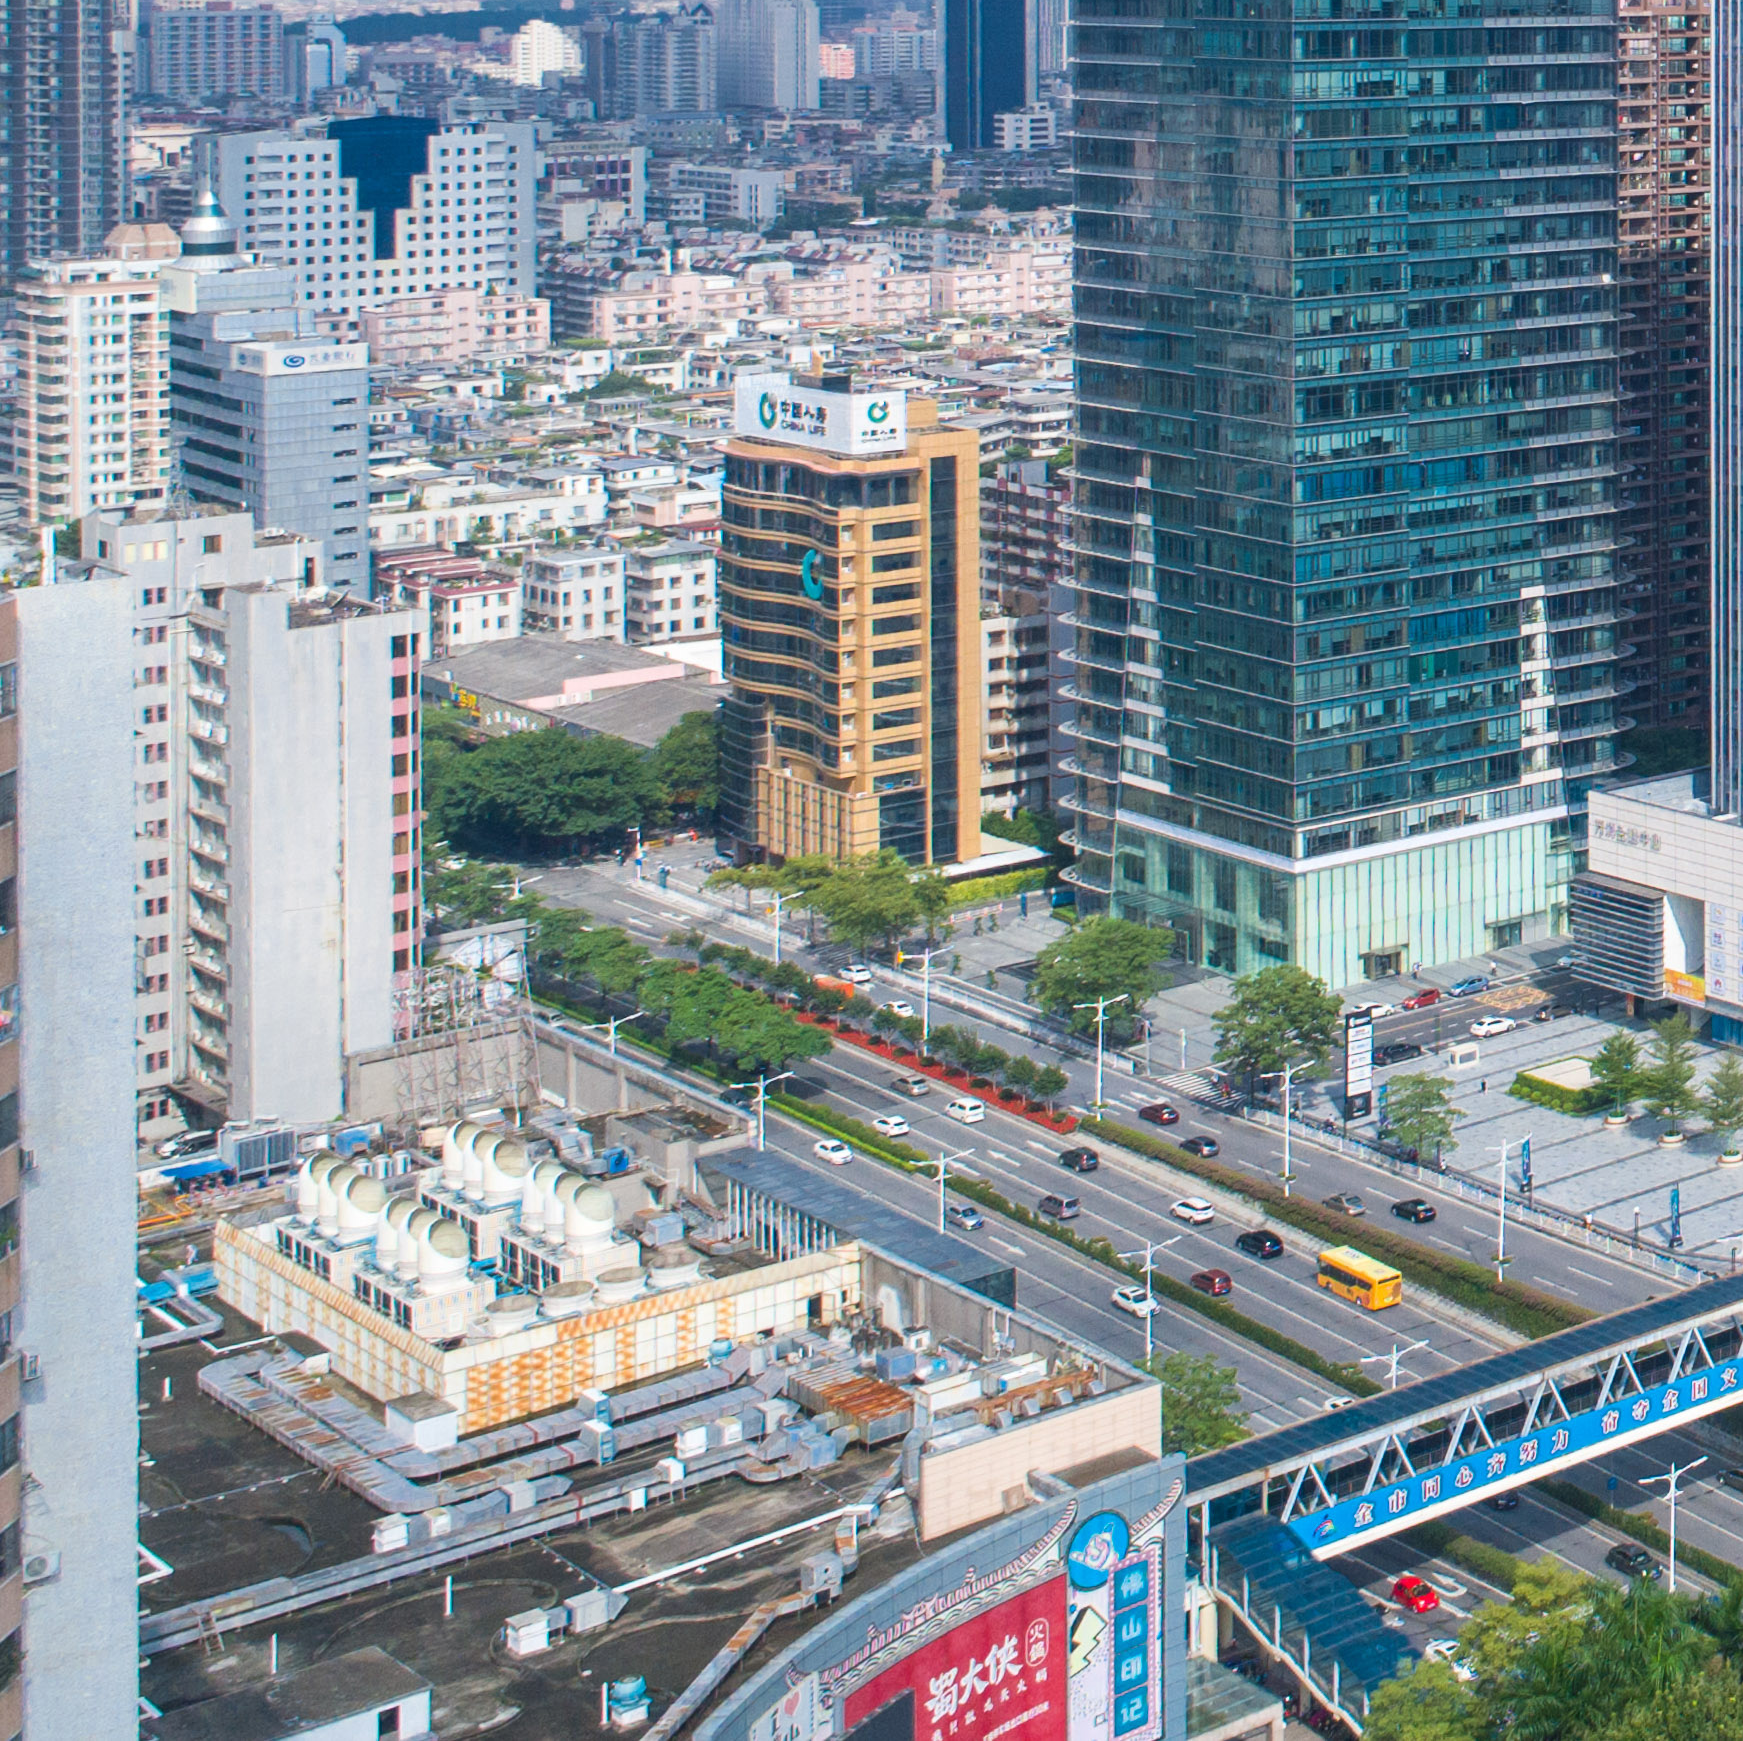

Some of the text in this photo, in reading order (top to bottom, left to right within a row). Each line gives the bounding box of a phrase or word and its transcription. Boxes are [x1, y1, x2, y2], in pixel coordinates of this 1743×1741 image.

[780, 399, 828, 424] 中国人寿
[780, 419, 828, 437] CHINA LIFE
[1354, 1429, 1570, 1528] 全市同心齐努力
[1029, 1624, 1046, 1663] 火锅
[924, 1634, 1024, 1724] 蜀大侠
